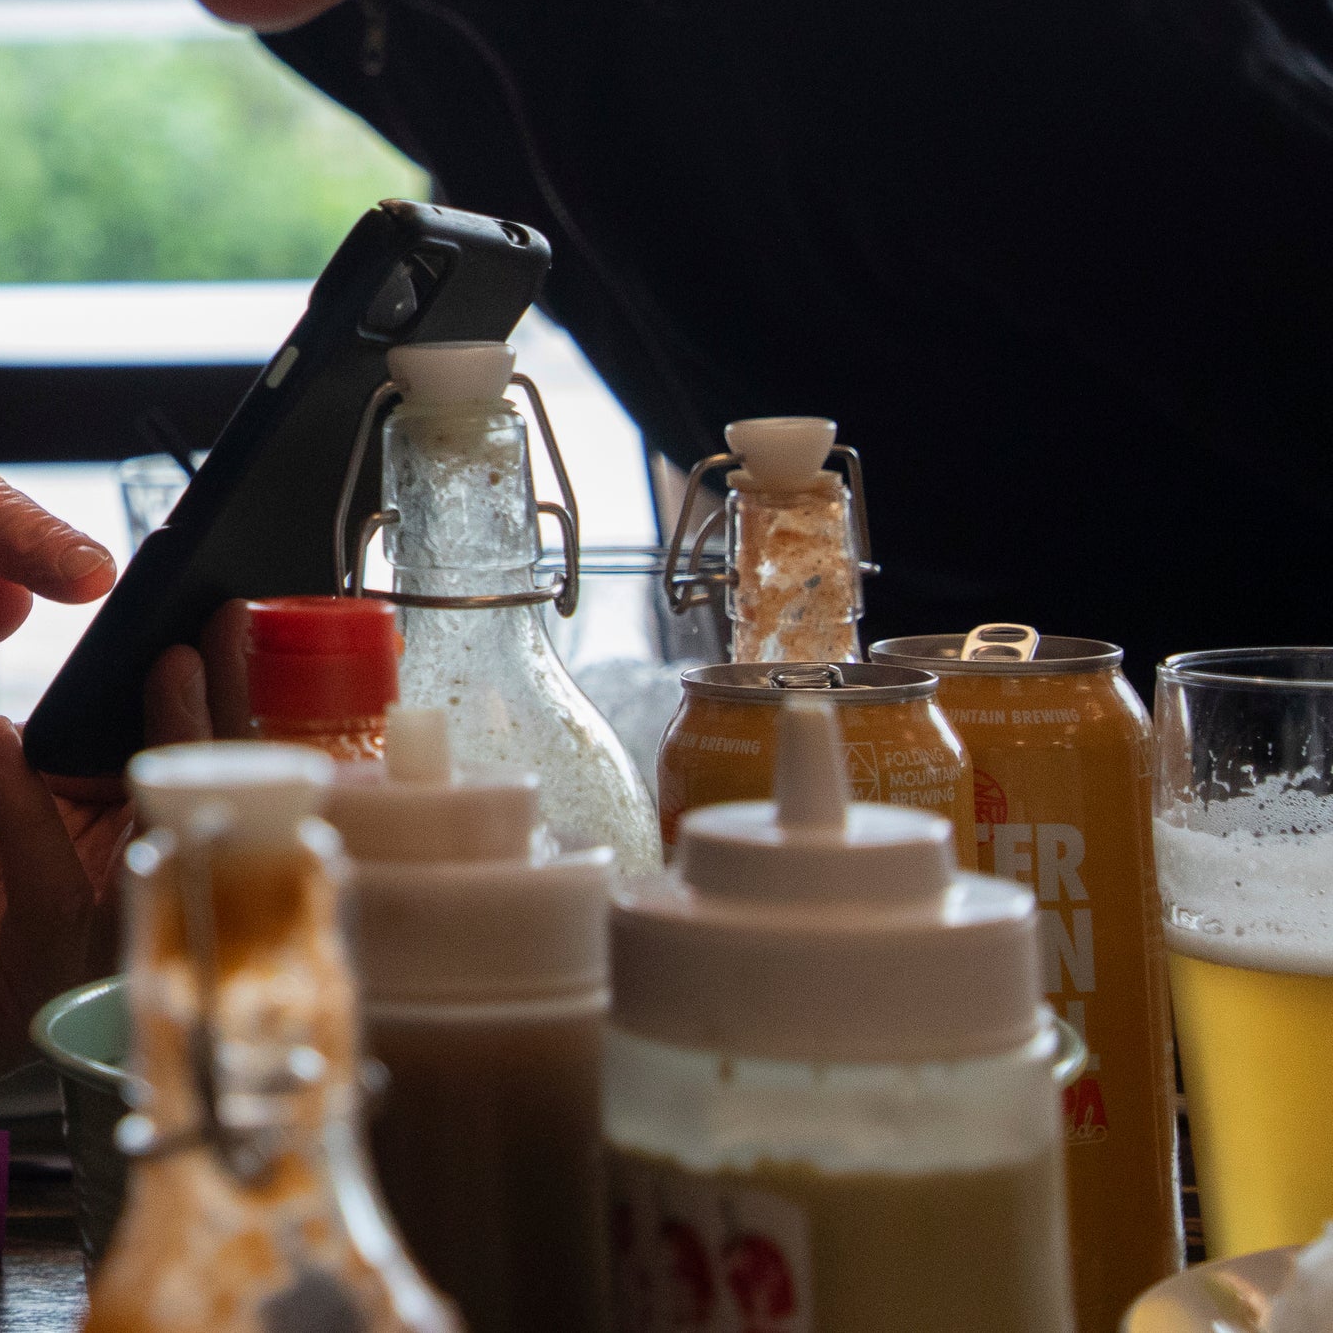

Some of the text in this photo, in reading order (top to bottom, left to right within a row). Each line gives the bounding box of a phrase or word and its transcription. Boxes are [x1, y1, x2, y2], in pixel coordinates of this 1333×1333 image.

[948, 708, 1081, 724] UNTAIN BREWING
[699, 735, 762, 756] BREWING
[884, 746, 945, 768] FOLDING
[889, 764, 961, 788] MOUNTAIN
[890, 785, 955, 805] BREWING
[978, 822, 1090, 901] ER
[1035, 908, 1096, 993] N
